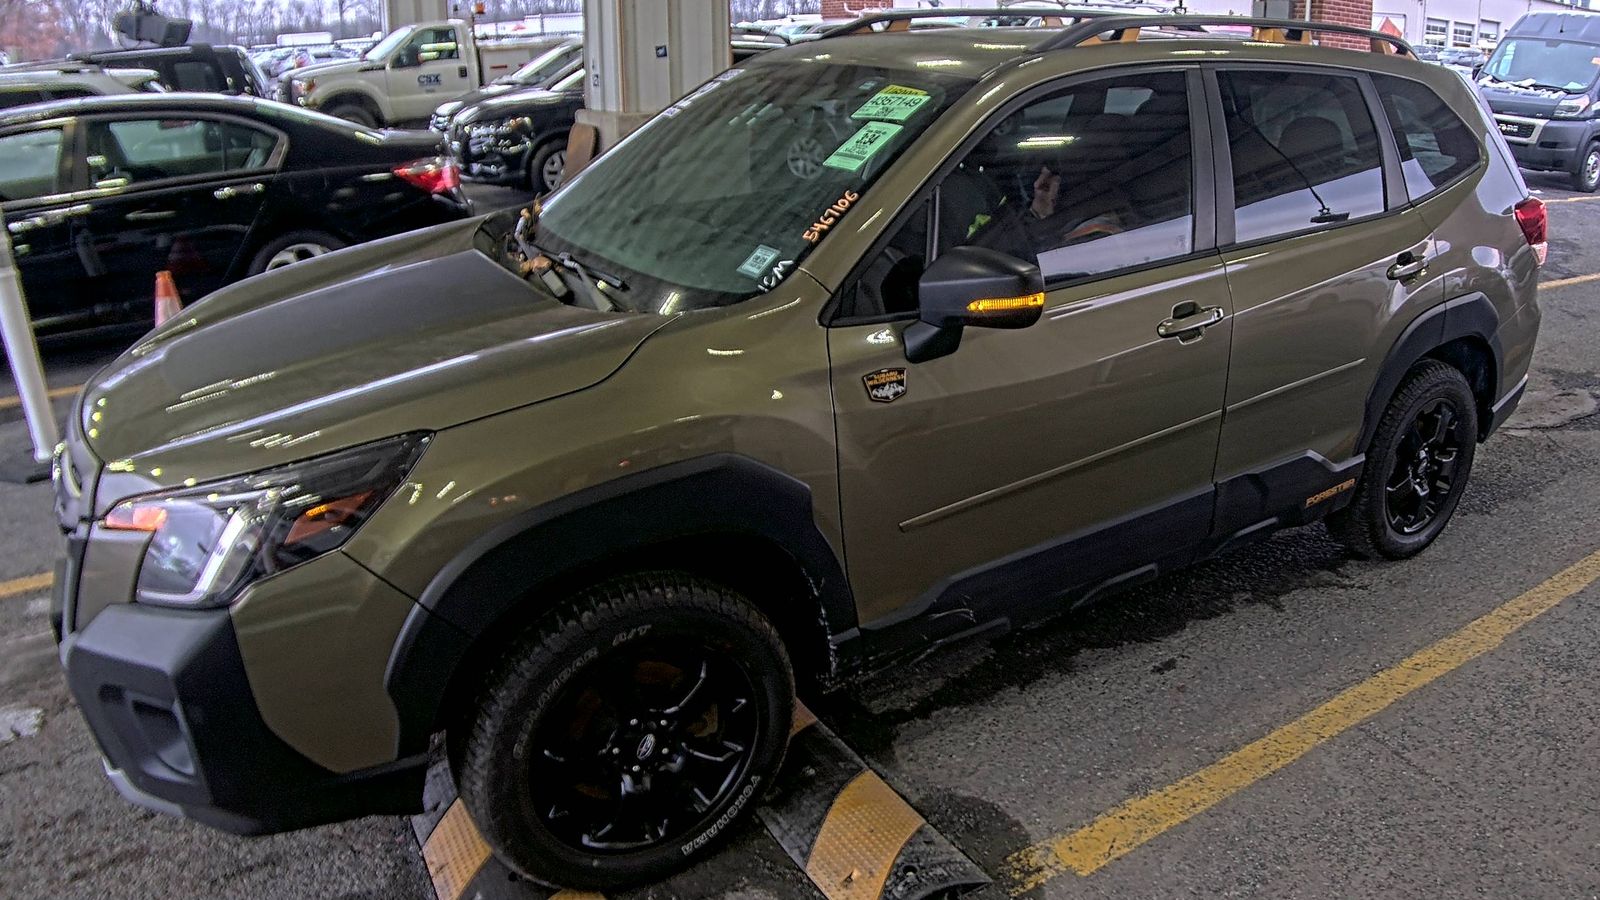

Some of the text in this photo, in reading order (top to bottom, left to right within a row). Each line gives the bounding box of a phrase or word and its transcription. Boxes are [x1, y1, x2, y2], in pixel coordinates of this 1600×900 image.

[417, 73, 442, 85] CSX
[802, 189, 859, 242] 5467106
[681, 775, 761, 856] YOKOHAMA
